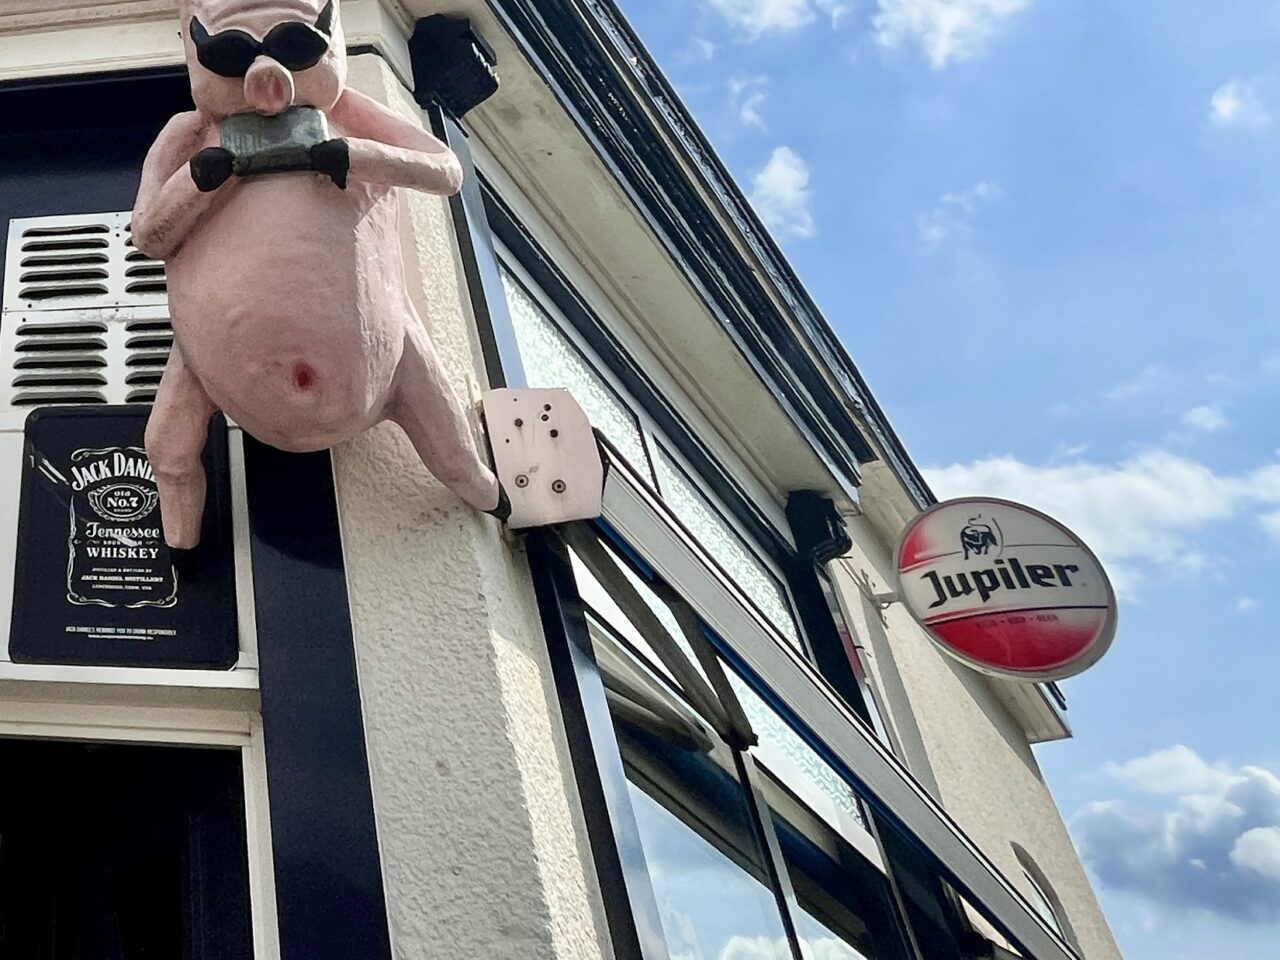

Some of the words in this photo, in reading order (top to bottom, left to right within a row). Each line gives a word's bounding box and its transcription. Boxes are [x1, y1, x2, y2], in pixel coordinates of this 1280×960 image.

[70, 459, 113, 491] JACK
[85, 521, 160, 538] Tennessee
[86, 546, 159, 559] WHISKEY
[920, 558, 1080, 609] Jupiler
